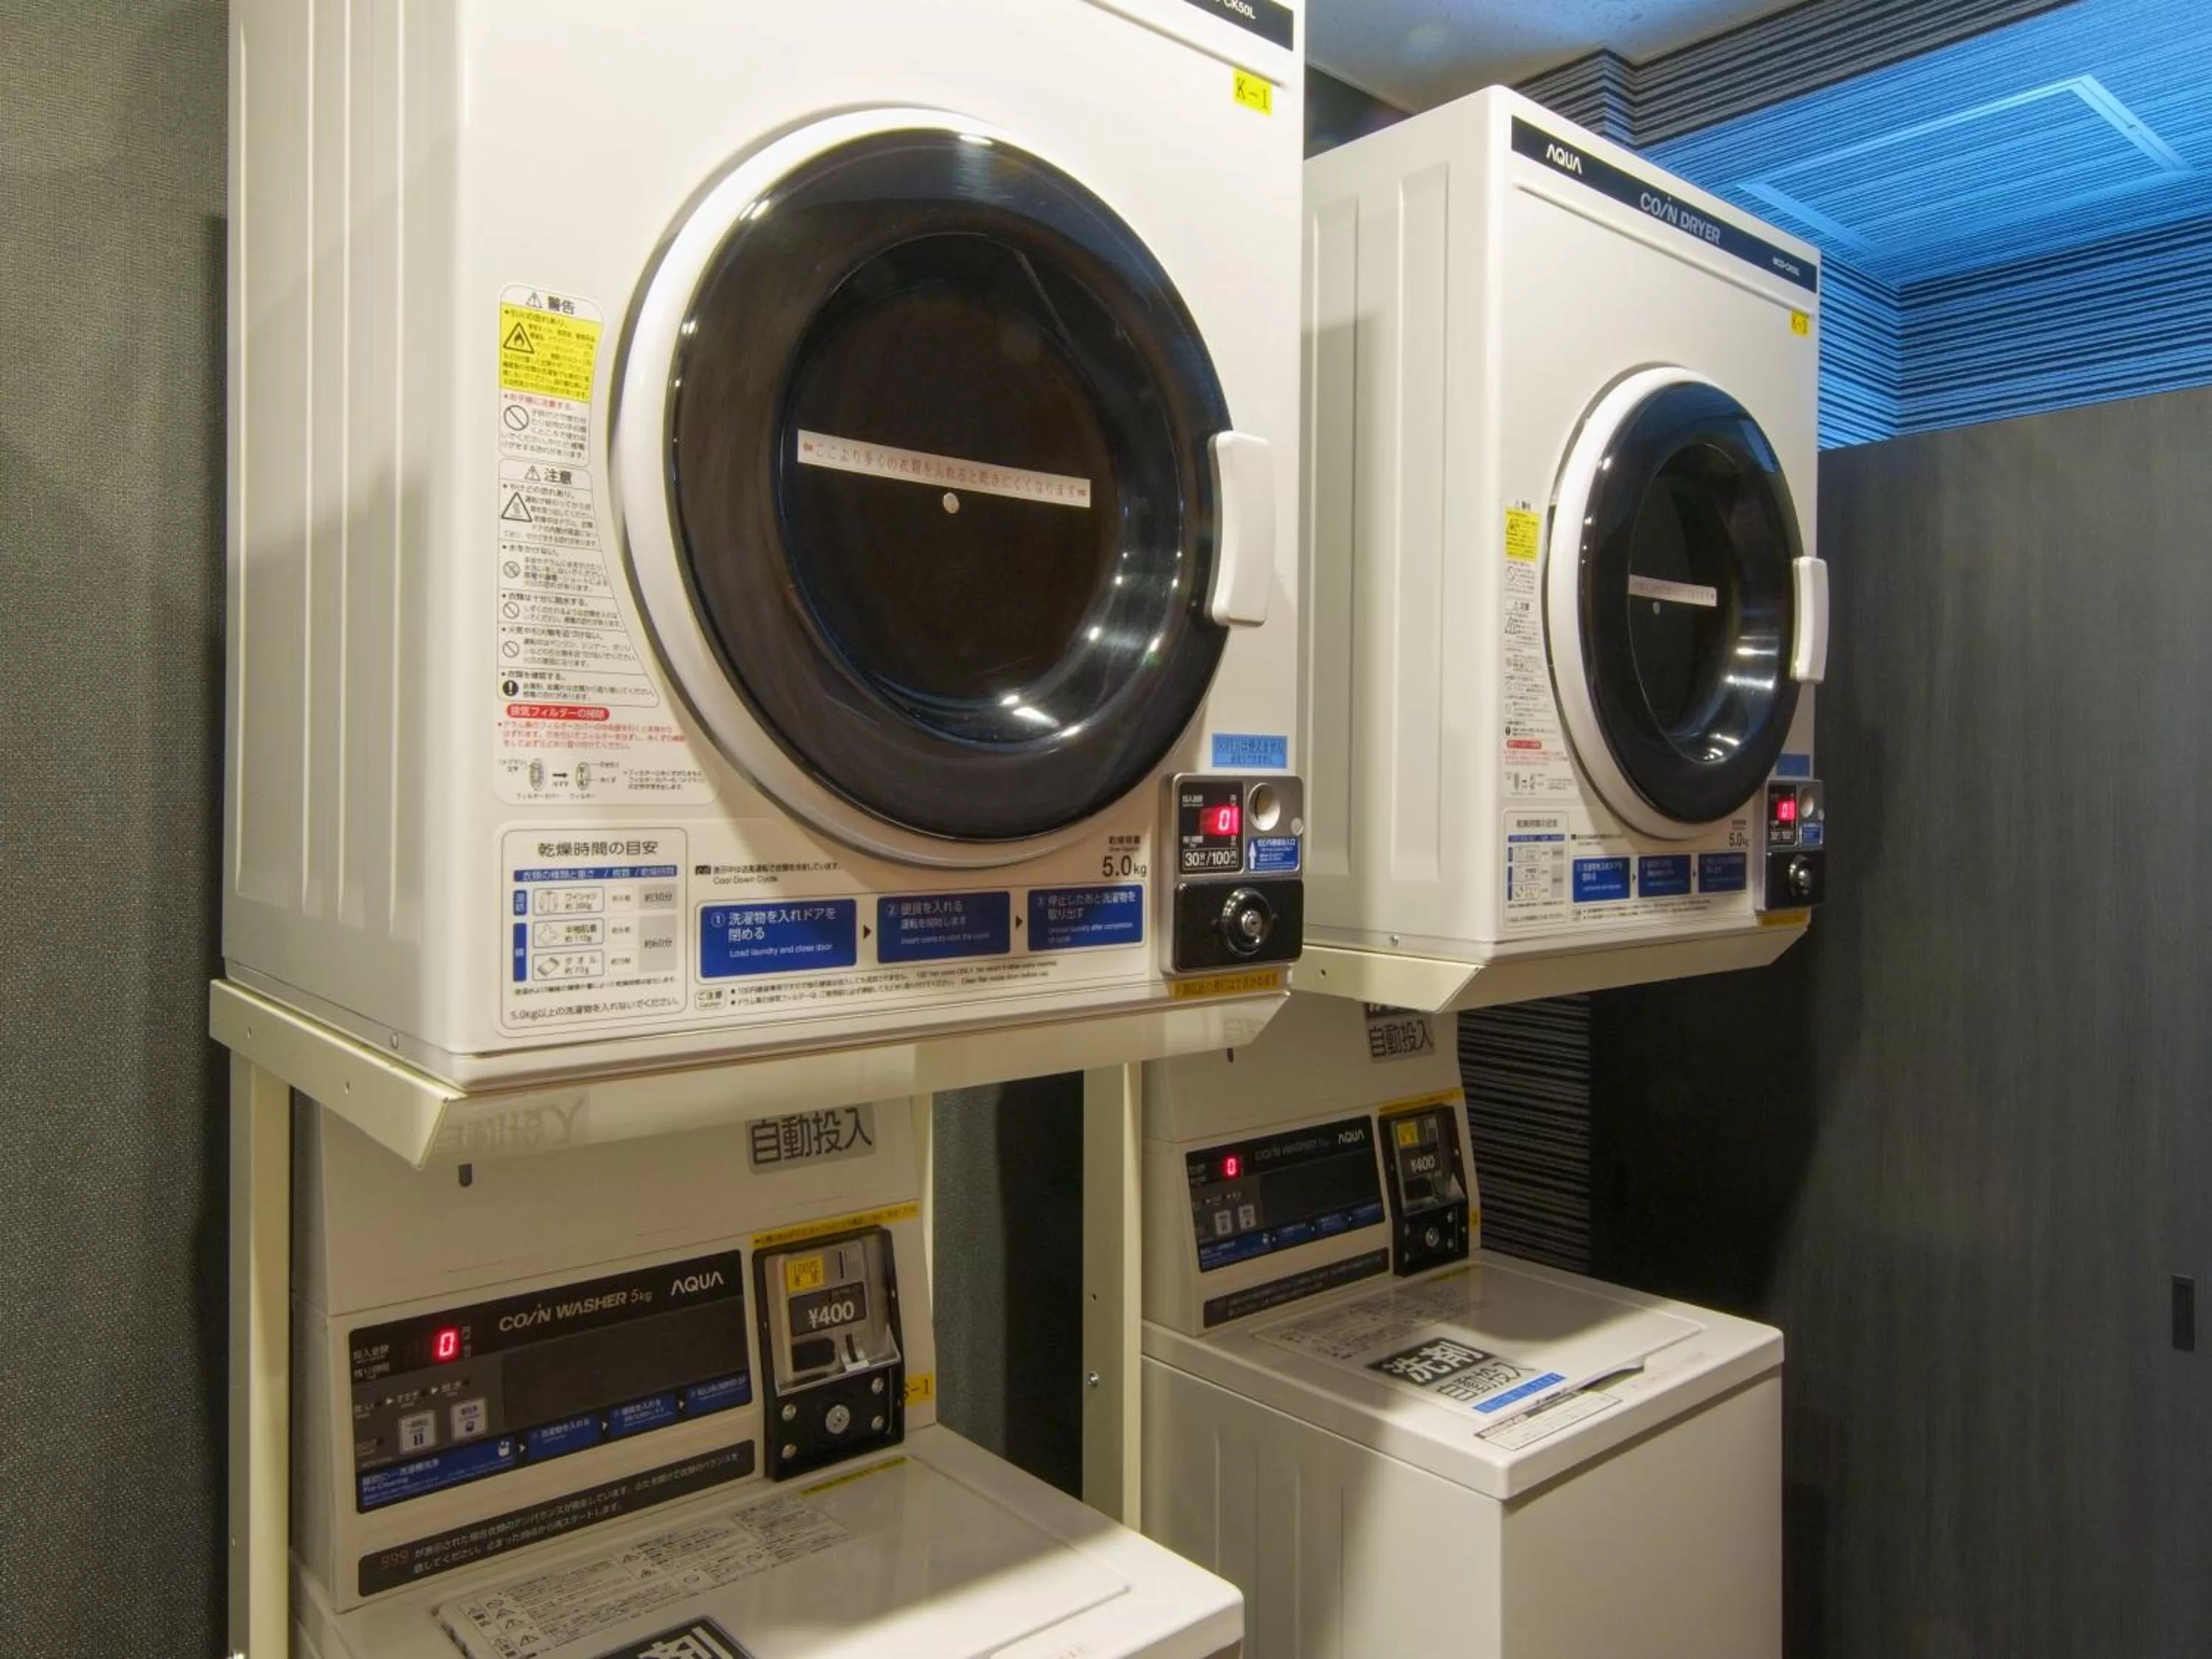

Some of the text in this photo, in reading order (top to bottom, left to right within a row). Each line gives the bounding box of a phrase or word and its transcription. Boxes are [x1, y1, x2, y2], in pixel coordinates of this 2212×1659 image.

[1546, 144, 1582, 175] AQUA
[1680, 211, 1721, 246] DRYER
[548, 296, 575, 315] 警告
[544, 468, 571, 484] 注意
[537, 841, 658, 858] 乾燥時間の目安
[728, 908, 837, 927] 洗濯物を入れドアを
[728, 927, 765, 943] 閉める
[1368, 1019, 1434, 1058] 自動投入
[751, 1107, 872, 1164] 自動投入
[1338, 1129, 1365, 1144] AQUA
[1227, 1159, 1237, 1176] 0
[670, 1271, 723, 1297] AQUA
[556, 1291, 627, 1320] WASHER
[630, 1287, 653, 1305] 5kg
[808, 1301, 855, 1329] ¥400
[439, 1332, 455, 1357] 0
[1382, 1340, 1484, 1383] 洗剤
